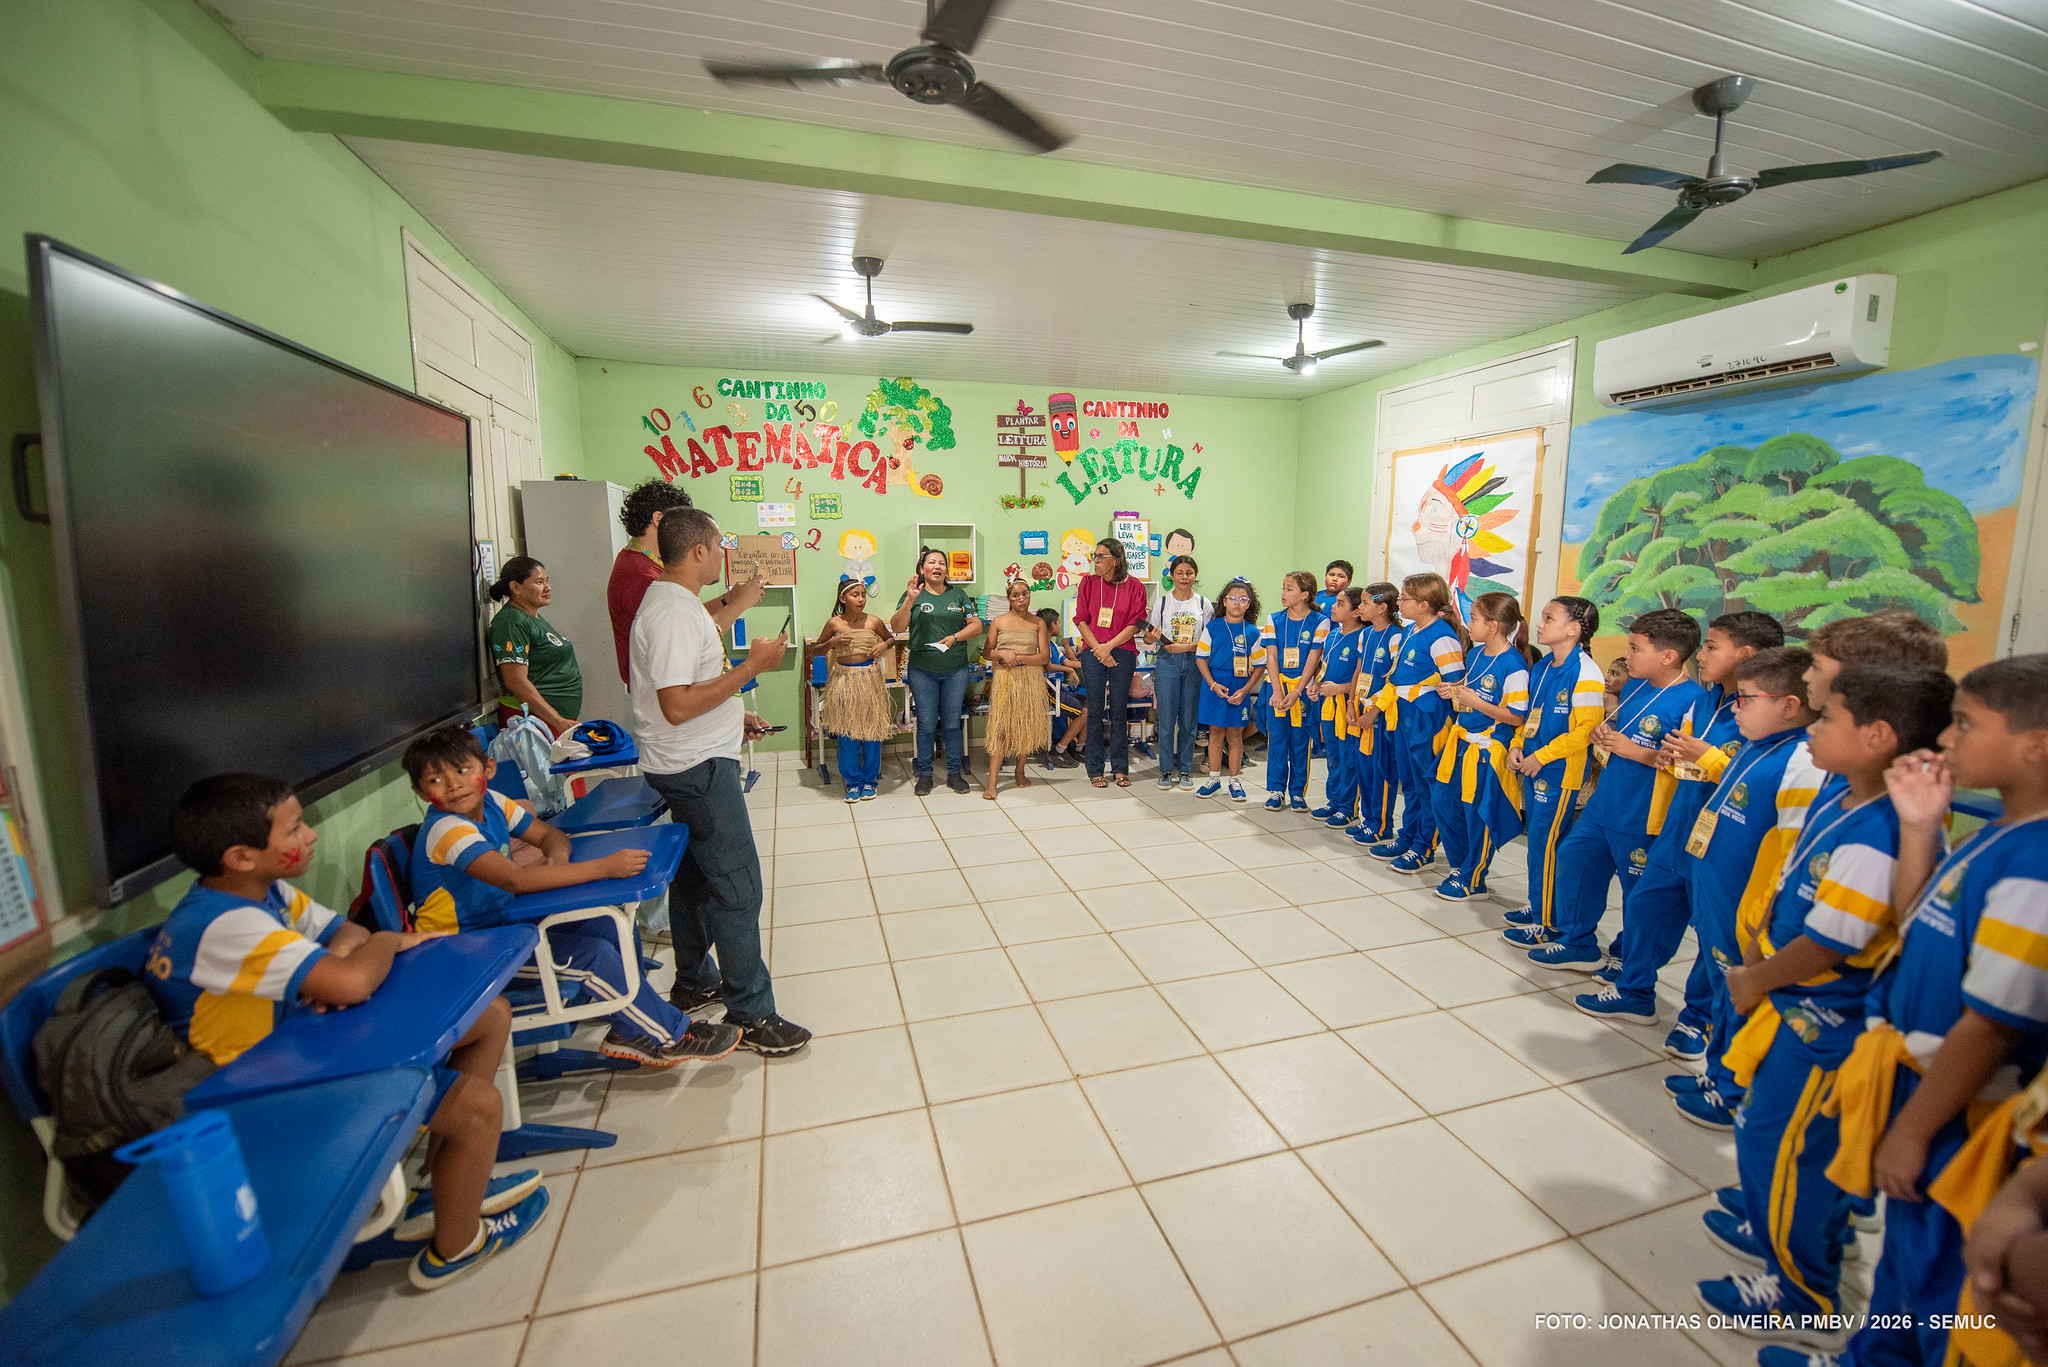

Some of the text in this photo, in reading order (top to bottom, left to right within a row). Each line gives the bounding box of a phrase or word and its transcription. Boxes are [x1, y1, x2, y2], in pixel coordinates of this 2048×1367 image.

[692, 385, 713, 409] 6
[717, 377, 827, 400] CANTINHO
[726, 402, 749, 427] 3
[765, 401, 792, 422] DA
[1082, 400, 1170, 419] CANTINHO
[675, 410, 697, 433] 7
[840, 418, 854, 442] 1
[1005, 416, 1039, 426] PLANTAR
[1117, 420, 1140, 438] DA
[998, 434, 1047, 446] LEITURA
[1161, 427, 1173, 440] H
[643, 420, 888, 496] MATEMÁTICA
[1018, 456, 1047, 468] HISTÓRIA
[1056, 438, 1203, 506] LEITURA
[784, 476, 804, 501] 4
[1097, 483, 1109, 495] U
[1117, 531, 1134, 539] LEVA
[1119, 523, 1143, 532] LER ME
[804, 528, 821, 551] 2
[1122, 541, 1137, 551] PARA
[1126, 551, 1147, 560] UGARES
